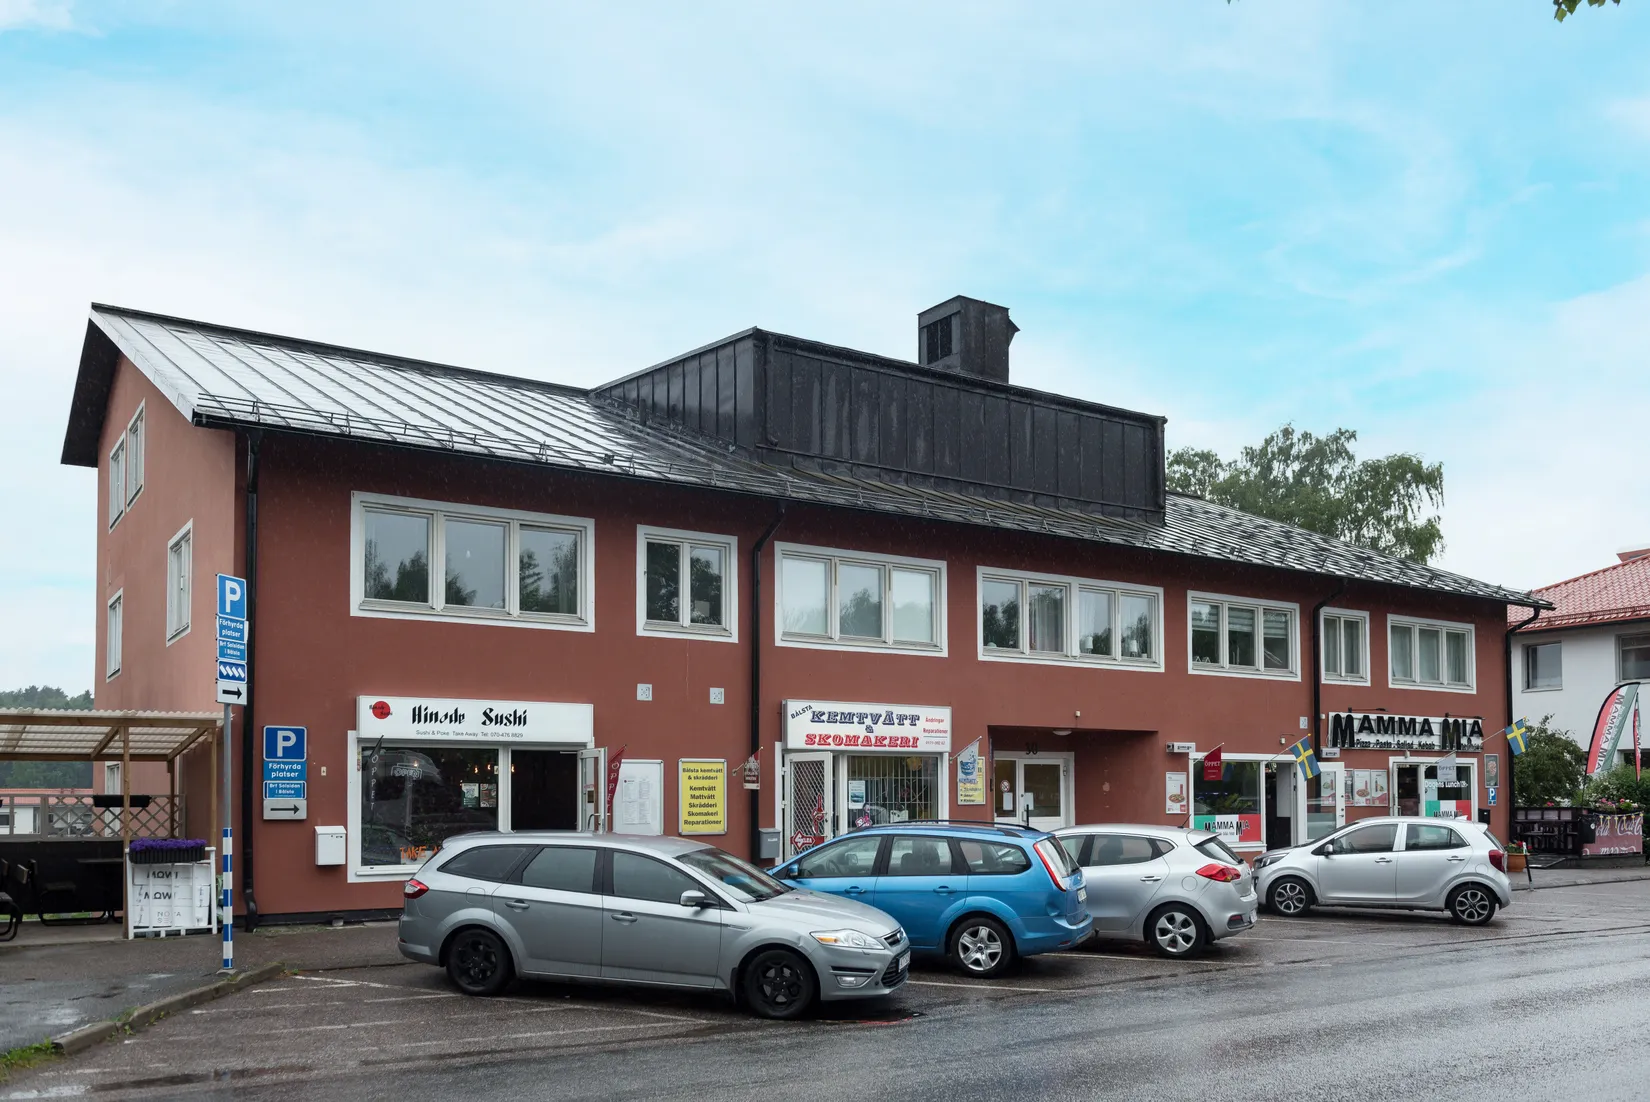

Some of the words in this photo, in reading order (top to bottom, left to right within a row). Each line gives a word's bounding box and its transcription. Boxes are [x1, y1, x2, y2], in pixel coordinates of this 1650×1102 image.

[225, 580, 242, 613] P
[219, 618, 243, 629] Förhyrda
[222, 629, 241, 638] platser
[411, 704, 465, 725] Hinode
[481, 707, 528, 727] Sushi
[790, 704, 813, 720] BÅLSTA
[810, 710, 920, 727] KEMTVÄTT
[1602, 693, 1626, 745] MAMMA
[864, 724, 874, 734] &
[1331, 713, 1435, 748] MAMMA
[1441, 718, 1484, 751] MIA
[276, 730, 297, 757] P
[804, 732, 920, 749] SKOMAKERI
[1025, 742, 1038, 755] 30
[268, 762, 302, 771] Förhyrda
[1595, 747, 1608, 771] MIA
[271, 770, 299, 778] platser
[1424, 781, 1444, 789] Dagens
[1489, 788, 1496, 800] P
[1204, 820, 1235, 832] MAMMA
[1235, 819, 1250, 836] MIA
[399, 845, 427, 860] TAKE
